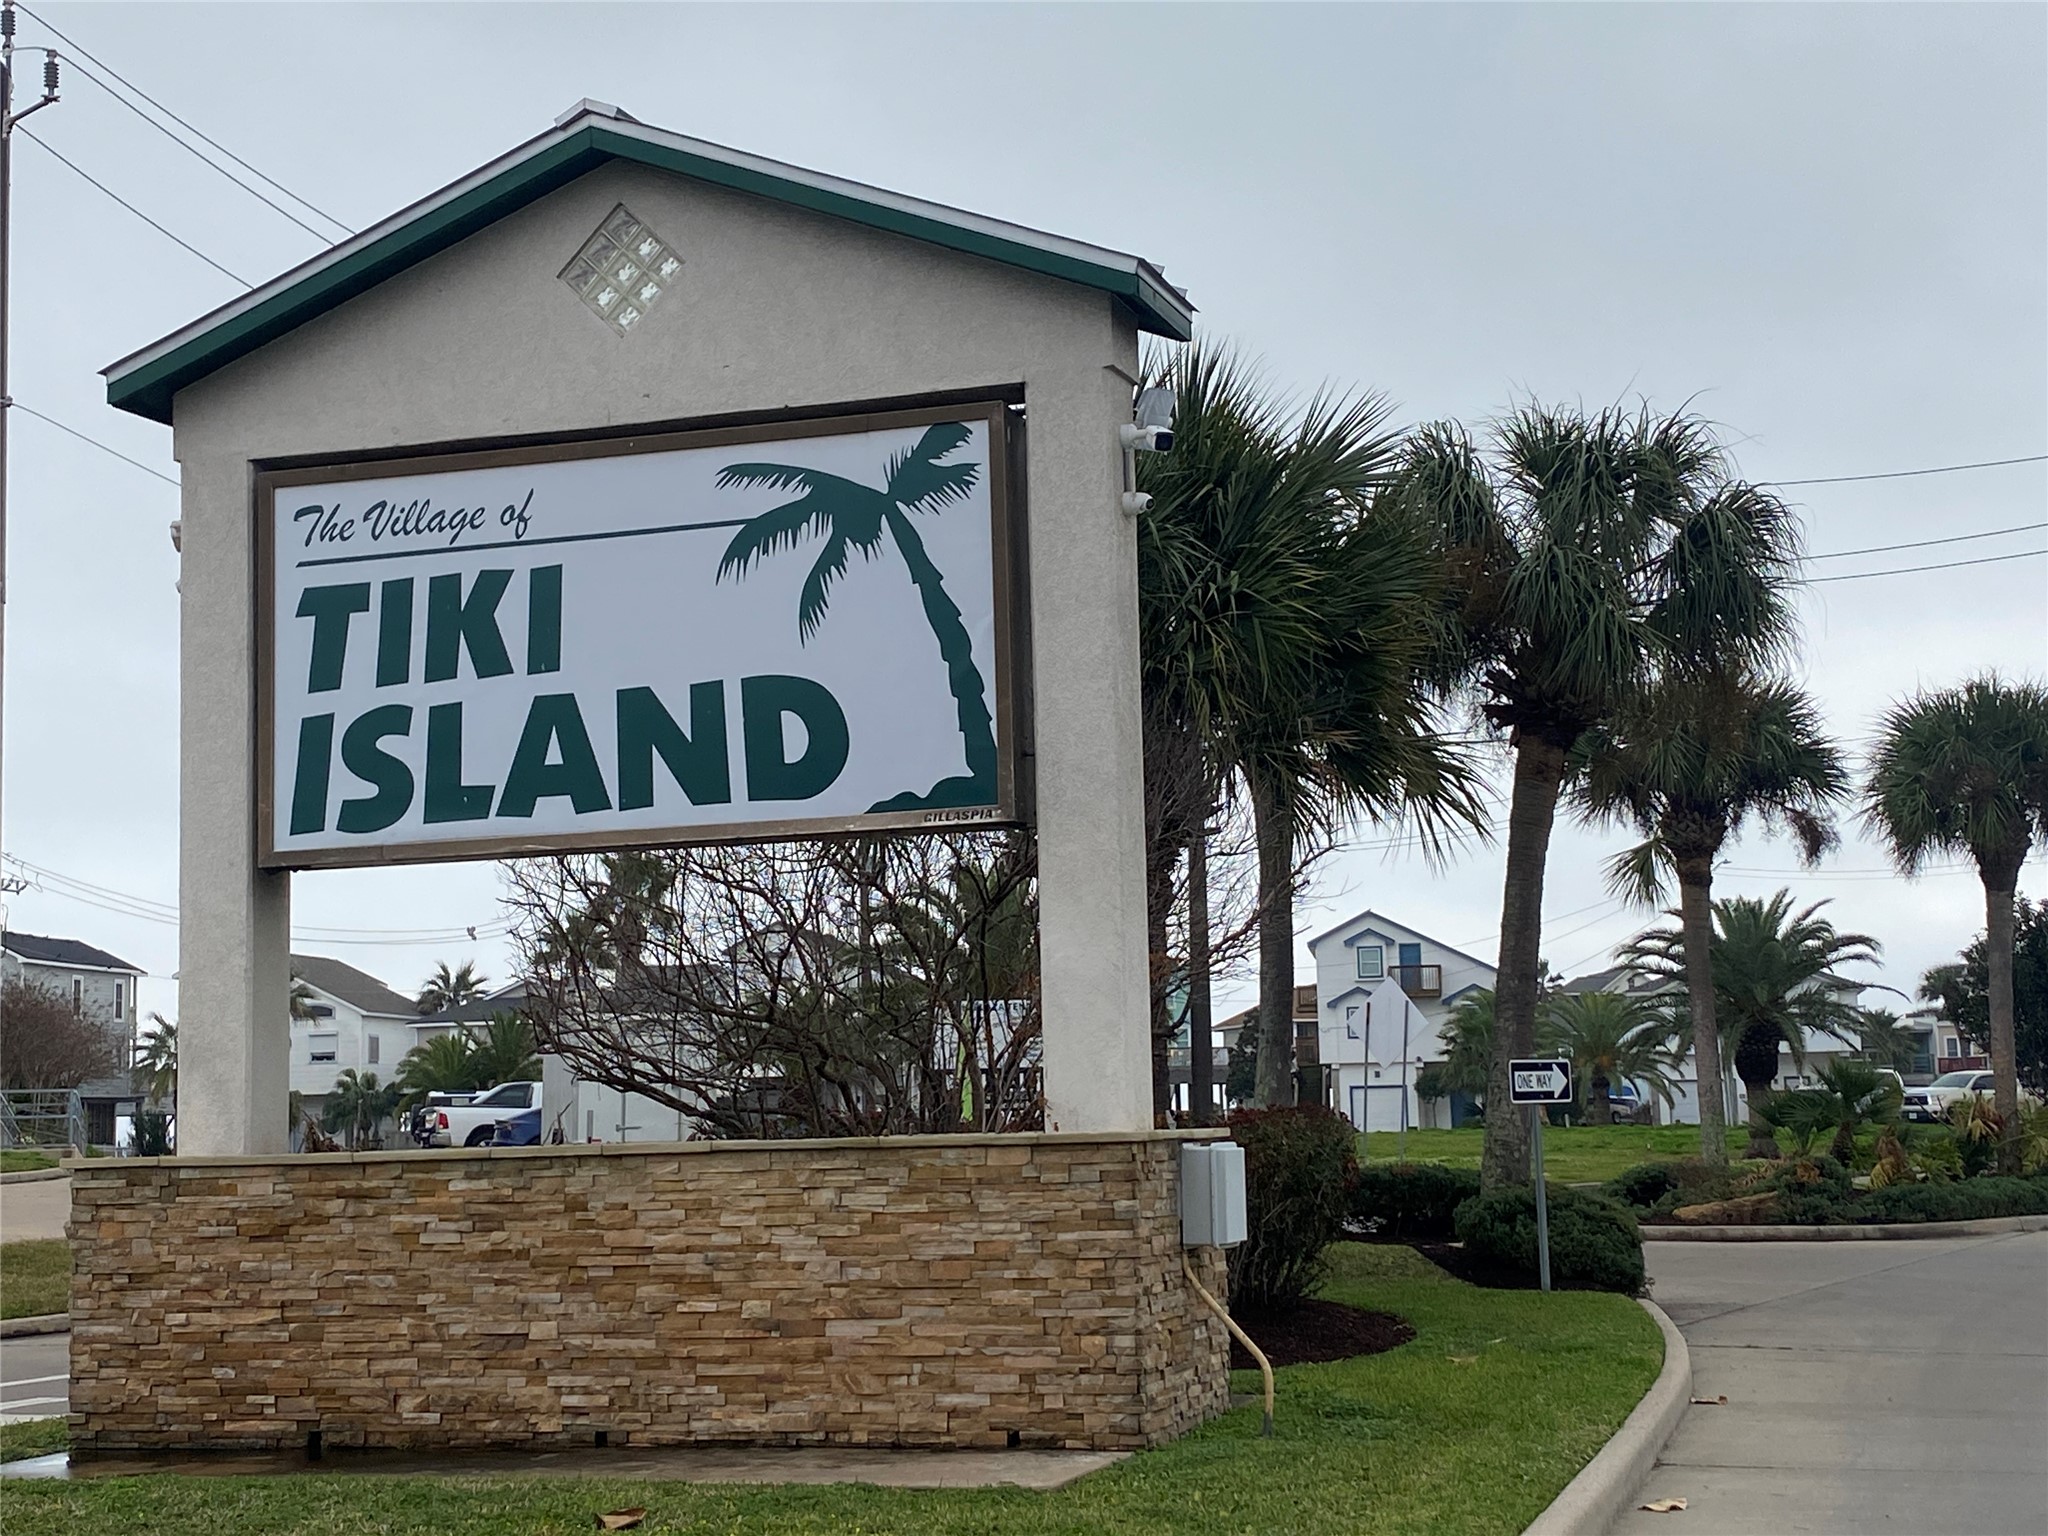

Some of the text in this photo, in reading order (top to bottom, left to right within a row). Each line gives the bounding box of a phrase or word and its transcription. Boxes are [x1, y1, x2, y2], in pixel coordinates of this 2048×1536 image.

[293, 487, 535, 548] The Village of
[294, 562, 563, 694] TIKI
[289, 674, 850, 837] ISLAND
[923, 808, 994, 823] GILLASPIA
[1517, 1073, 1552, 1089] ONE WAY
